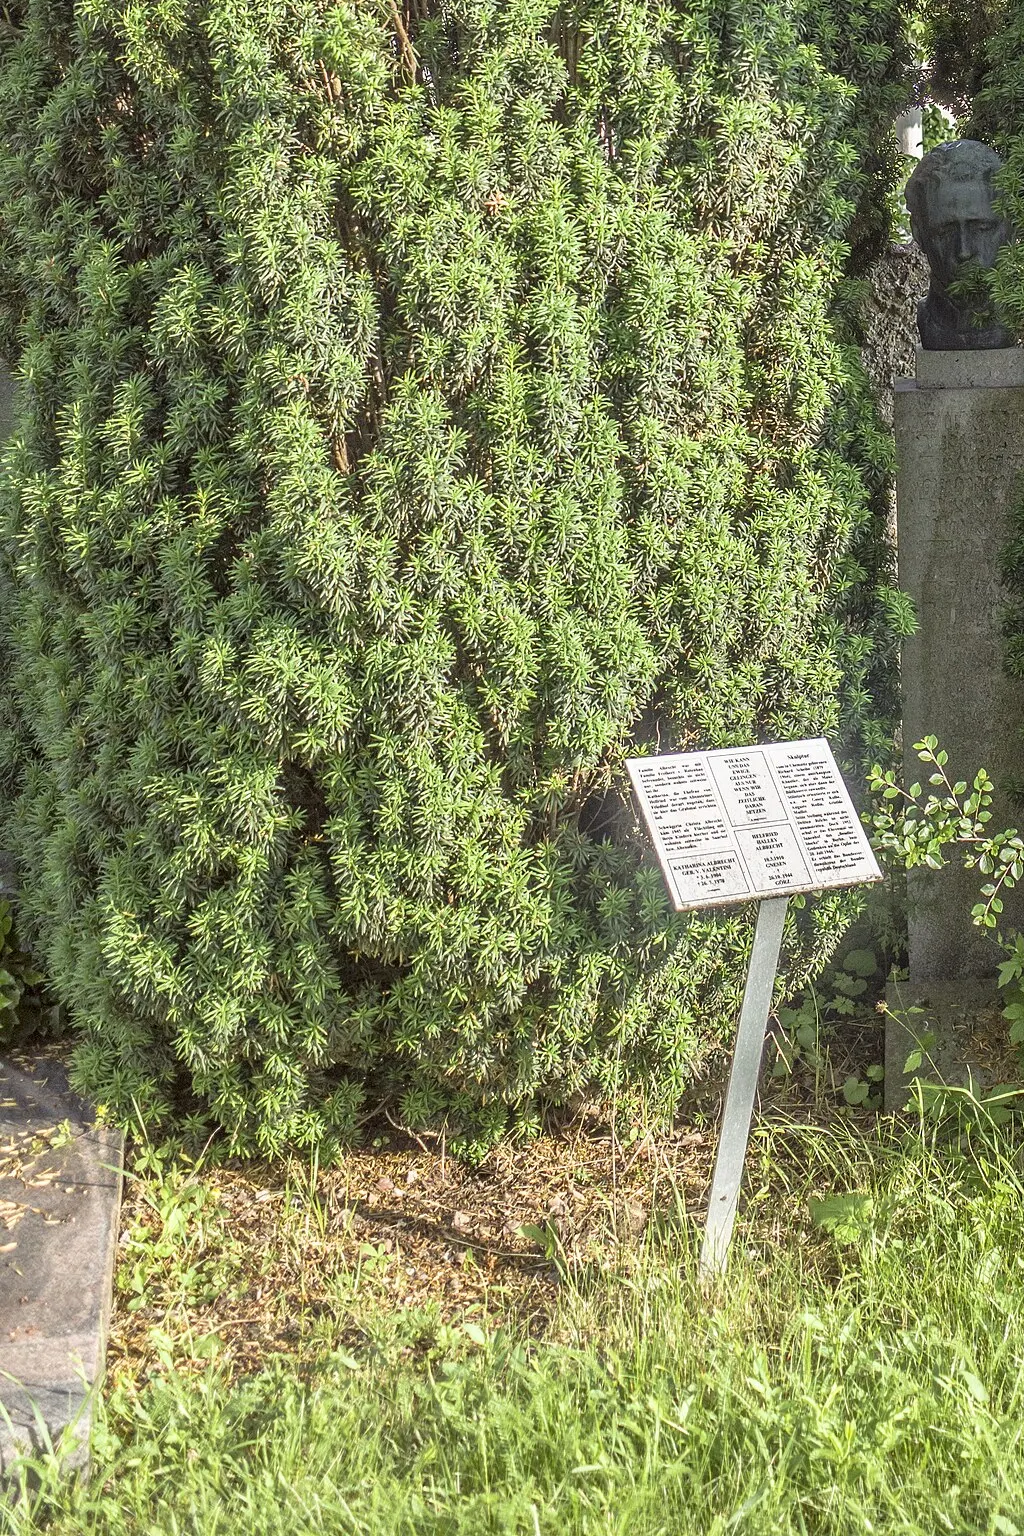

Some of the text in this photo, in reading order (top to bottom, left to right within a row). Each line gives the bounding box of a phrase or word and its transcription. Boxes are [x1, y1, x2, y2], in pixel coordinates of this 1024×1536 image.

[728, 773, 757, 781] GELINGEN
[737, 796, 765, 804] ZEITLICHE
[751, 831, 779, 839] HELFRIED
[755, 842, 783, 851] ALBRECHT
[672, 857, 735, 871] KATHARINA ALBRECHT
[764, 860, 787, 868] GNESEN
